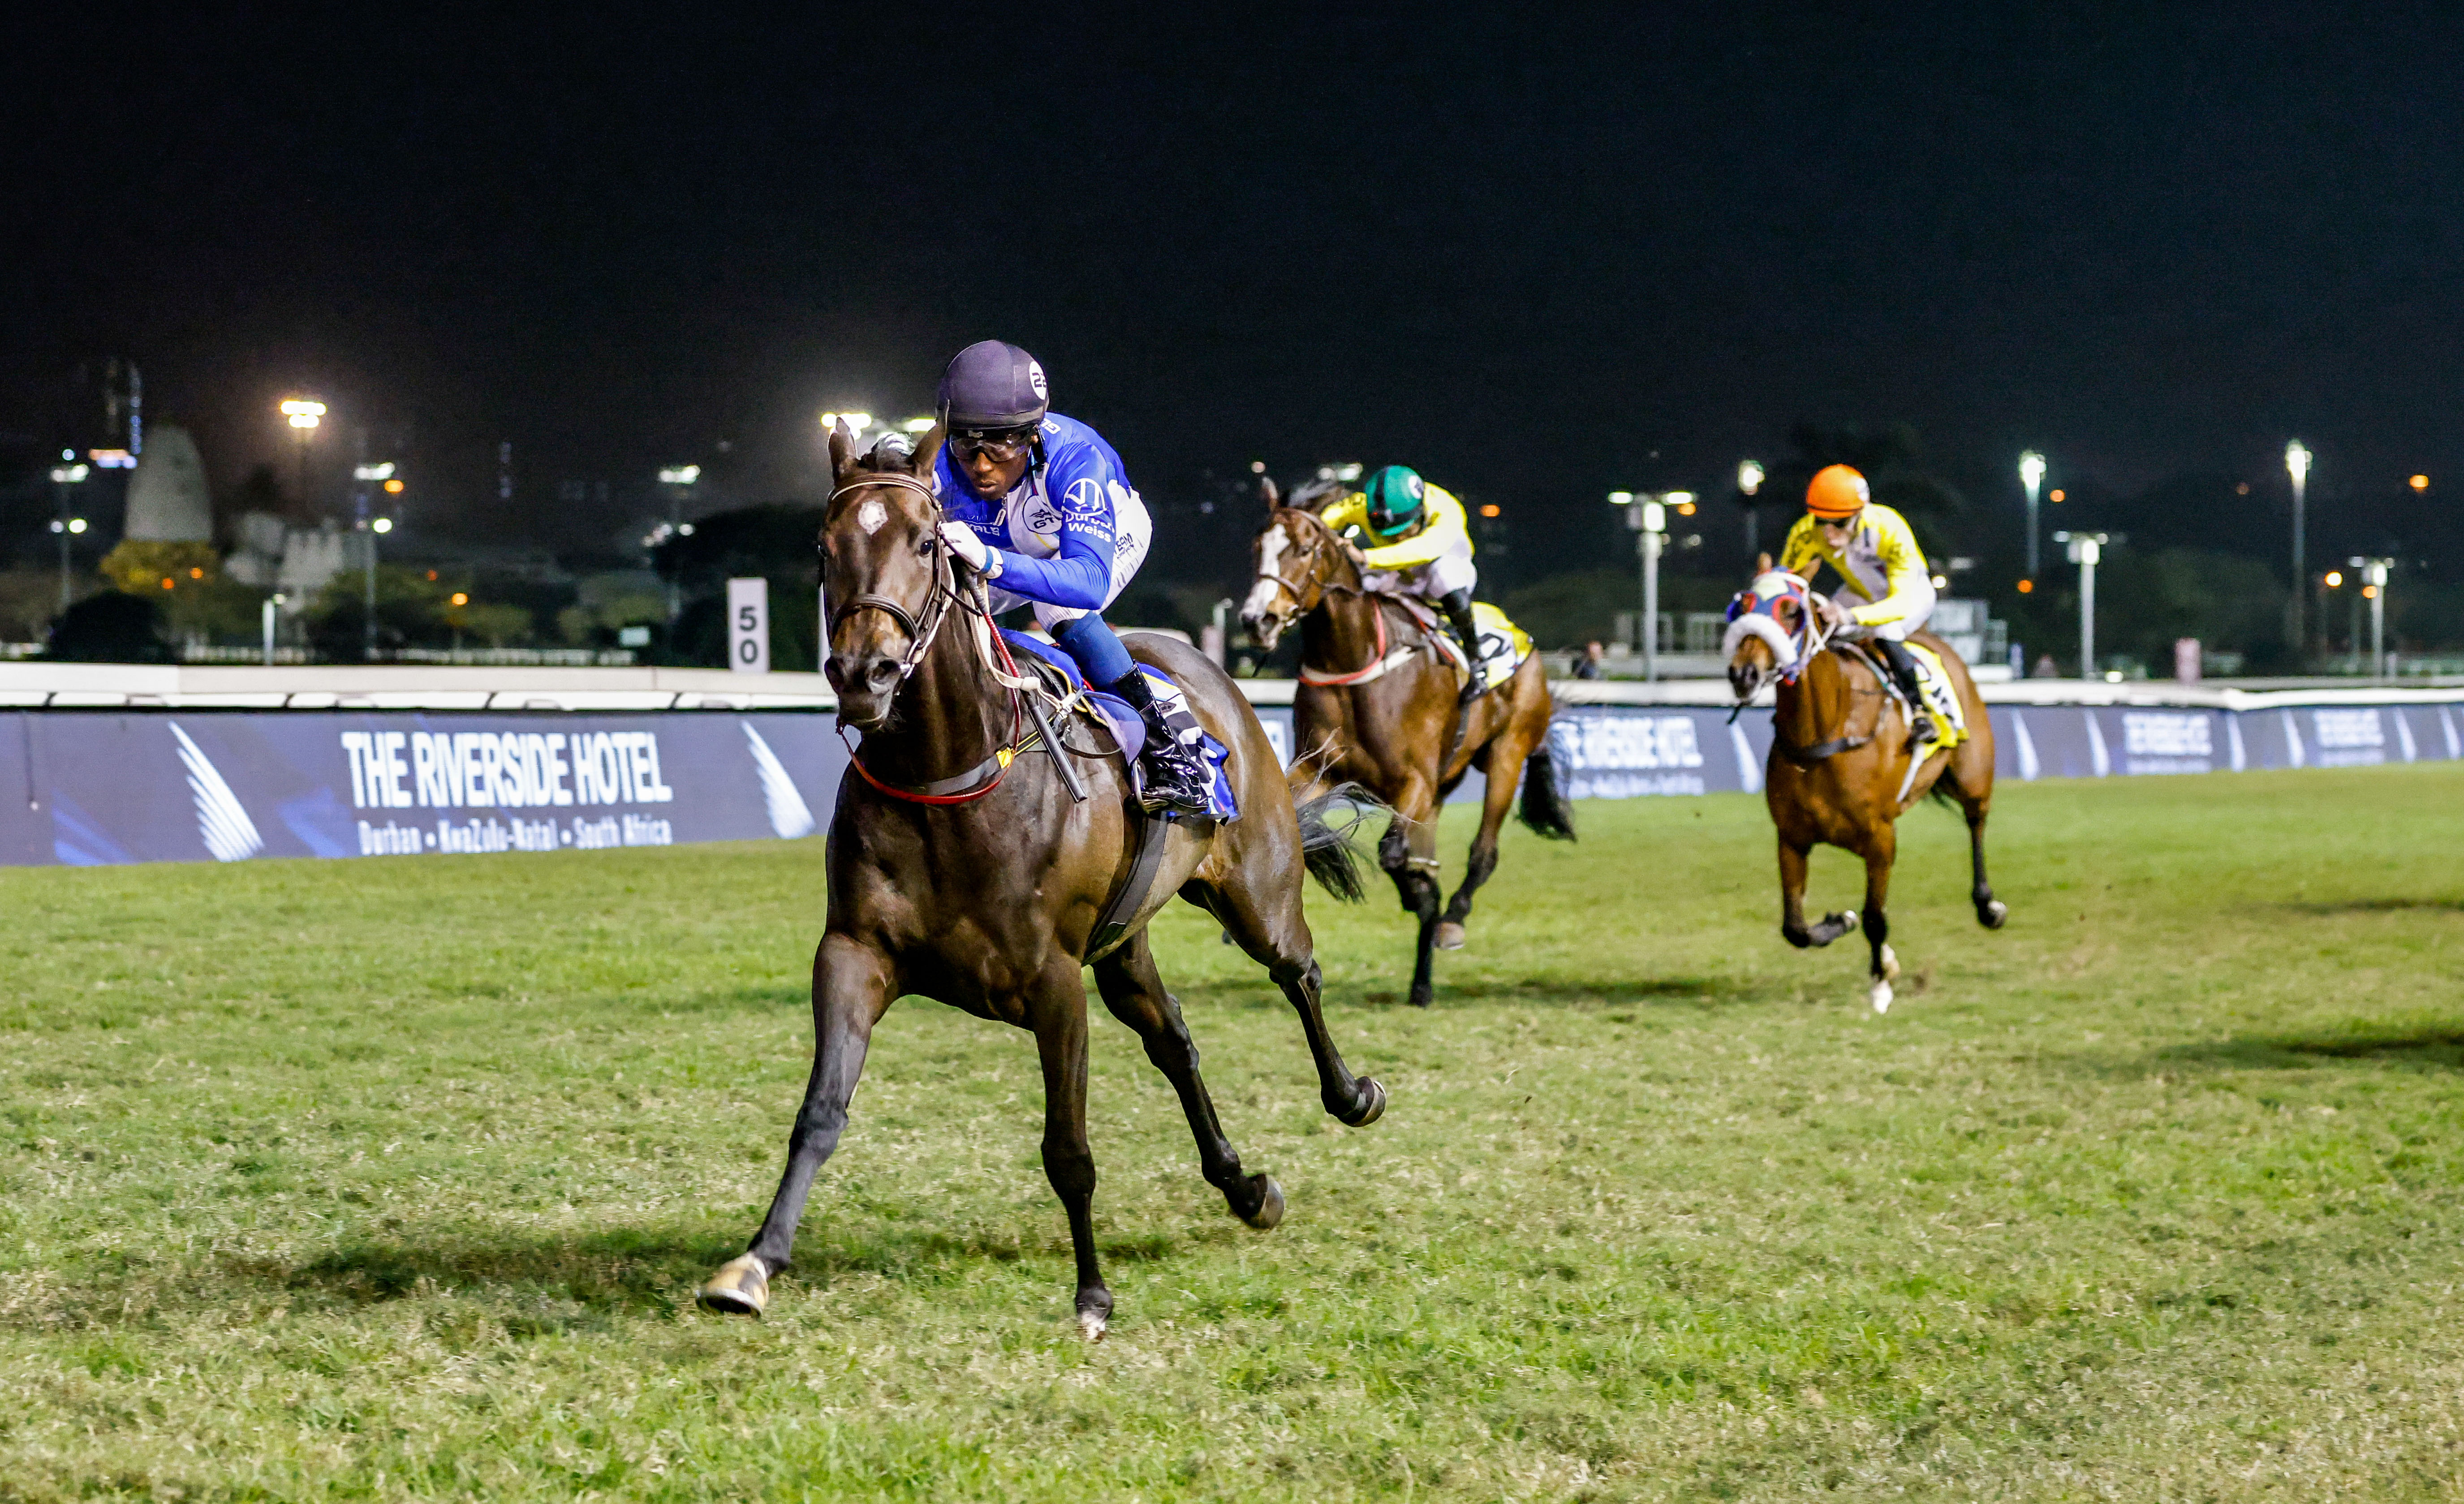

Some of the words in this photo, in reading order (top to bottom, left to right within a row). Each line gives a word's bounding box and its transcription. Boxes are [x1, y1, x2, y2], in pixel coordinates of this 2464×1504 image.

[1068, 522, 1111, 543] Weiss
[739, 606, 758, 664] 50
[341, 731, 413, 807] THE
[412, 731, 573, 807] RIVERSIDE
[571, 731, 673, 805] HOTEL
